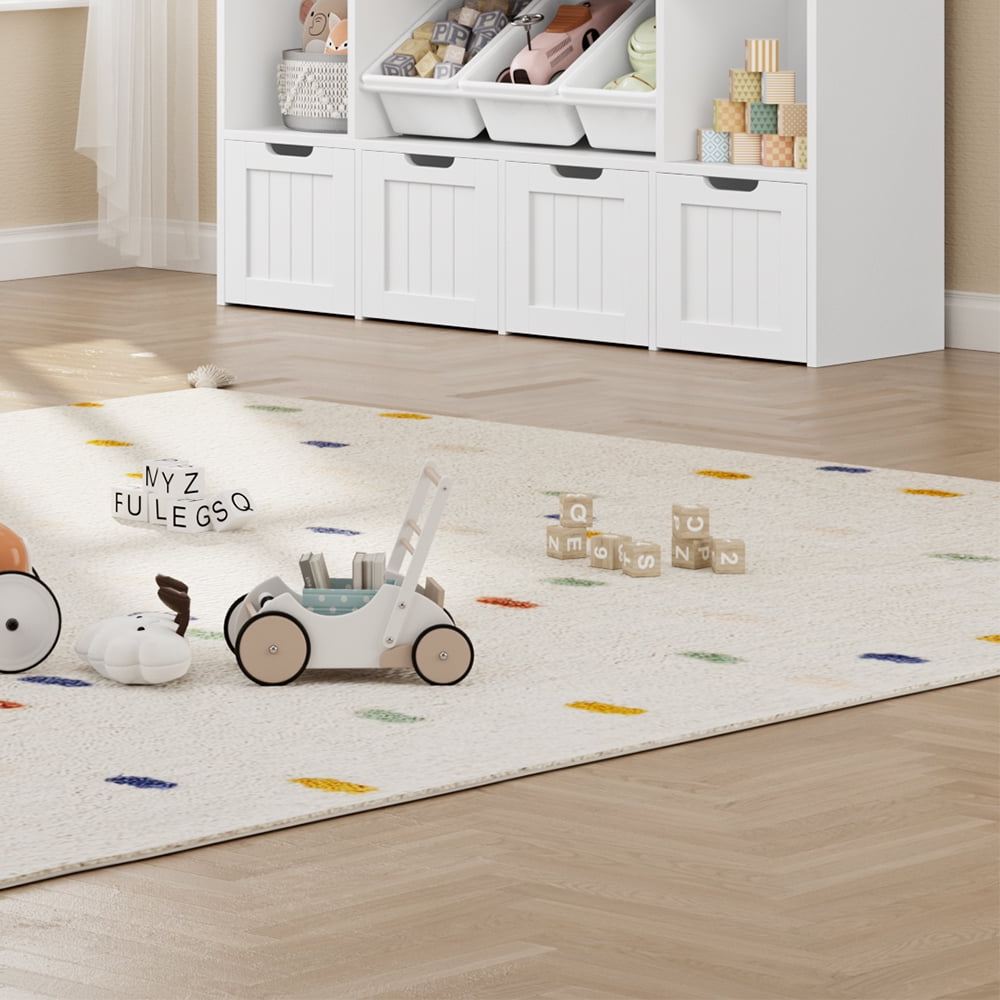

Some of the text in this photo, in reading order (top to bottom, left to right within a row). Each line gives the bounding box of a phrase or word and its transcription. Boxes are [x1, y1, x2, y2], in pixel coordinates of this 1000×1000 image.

[435, 23, 447, 41] P
[449, 26, 468, 45] P
[570, 503, 587, 523] Q
